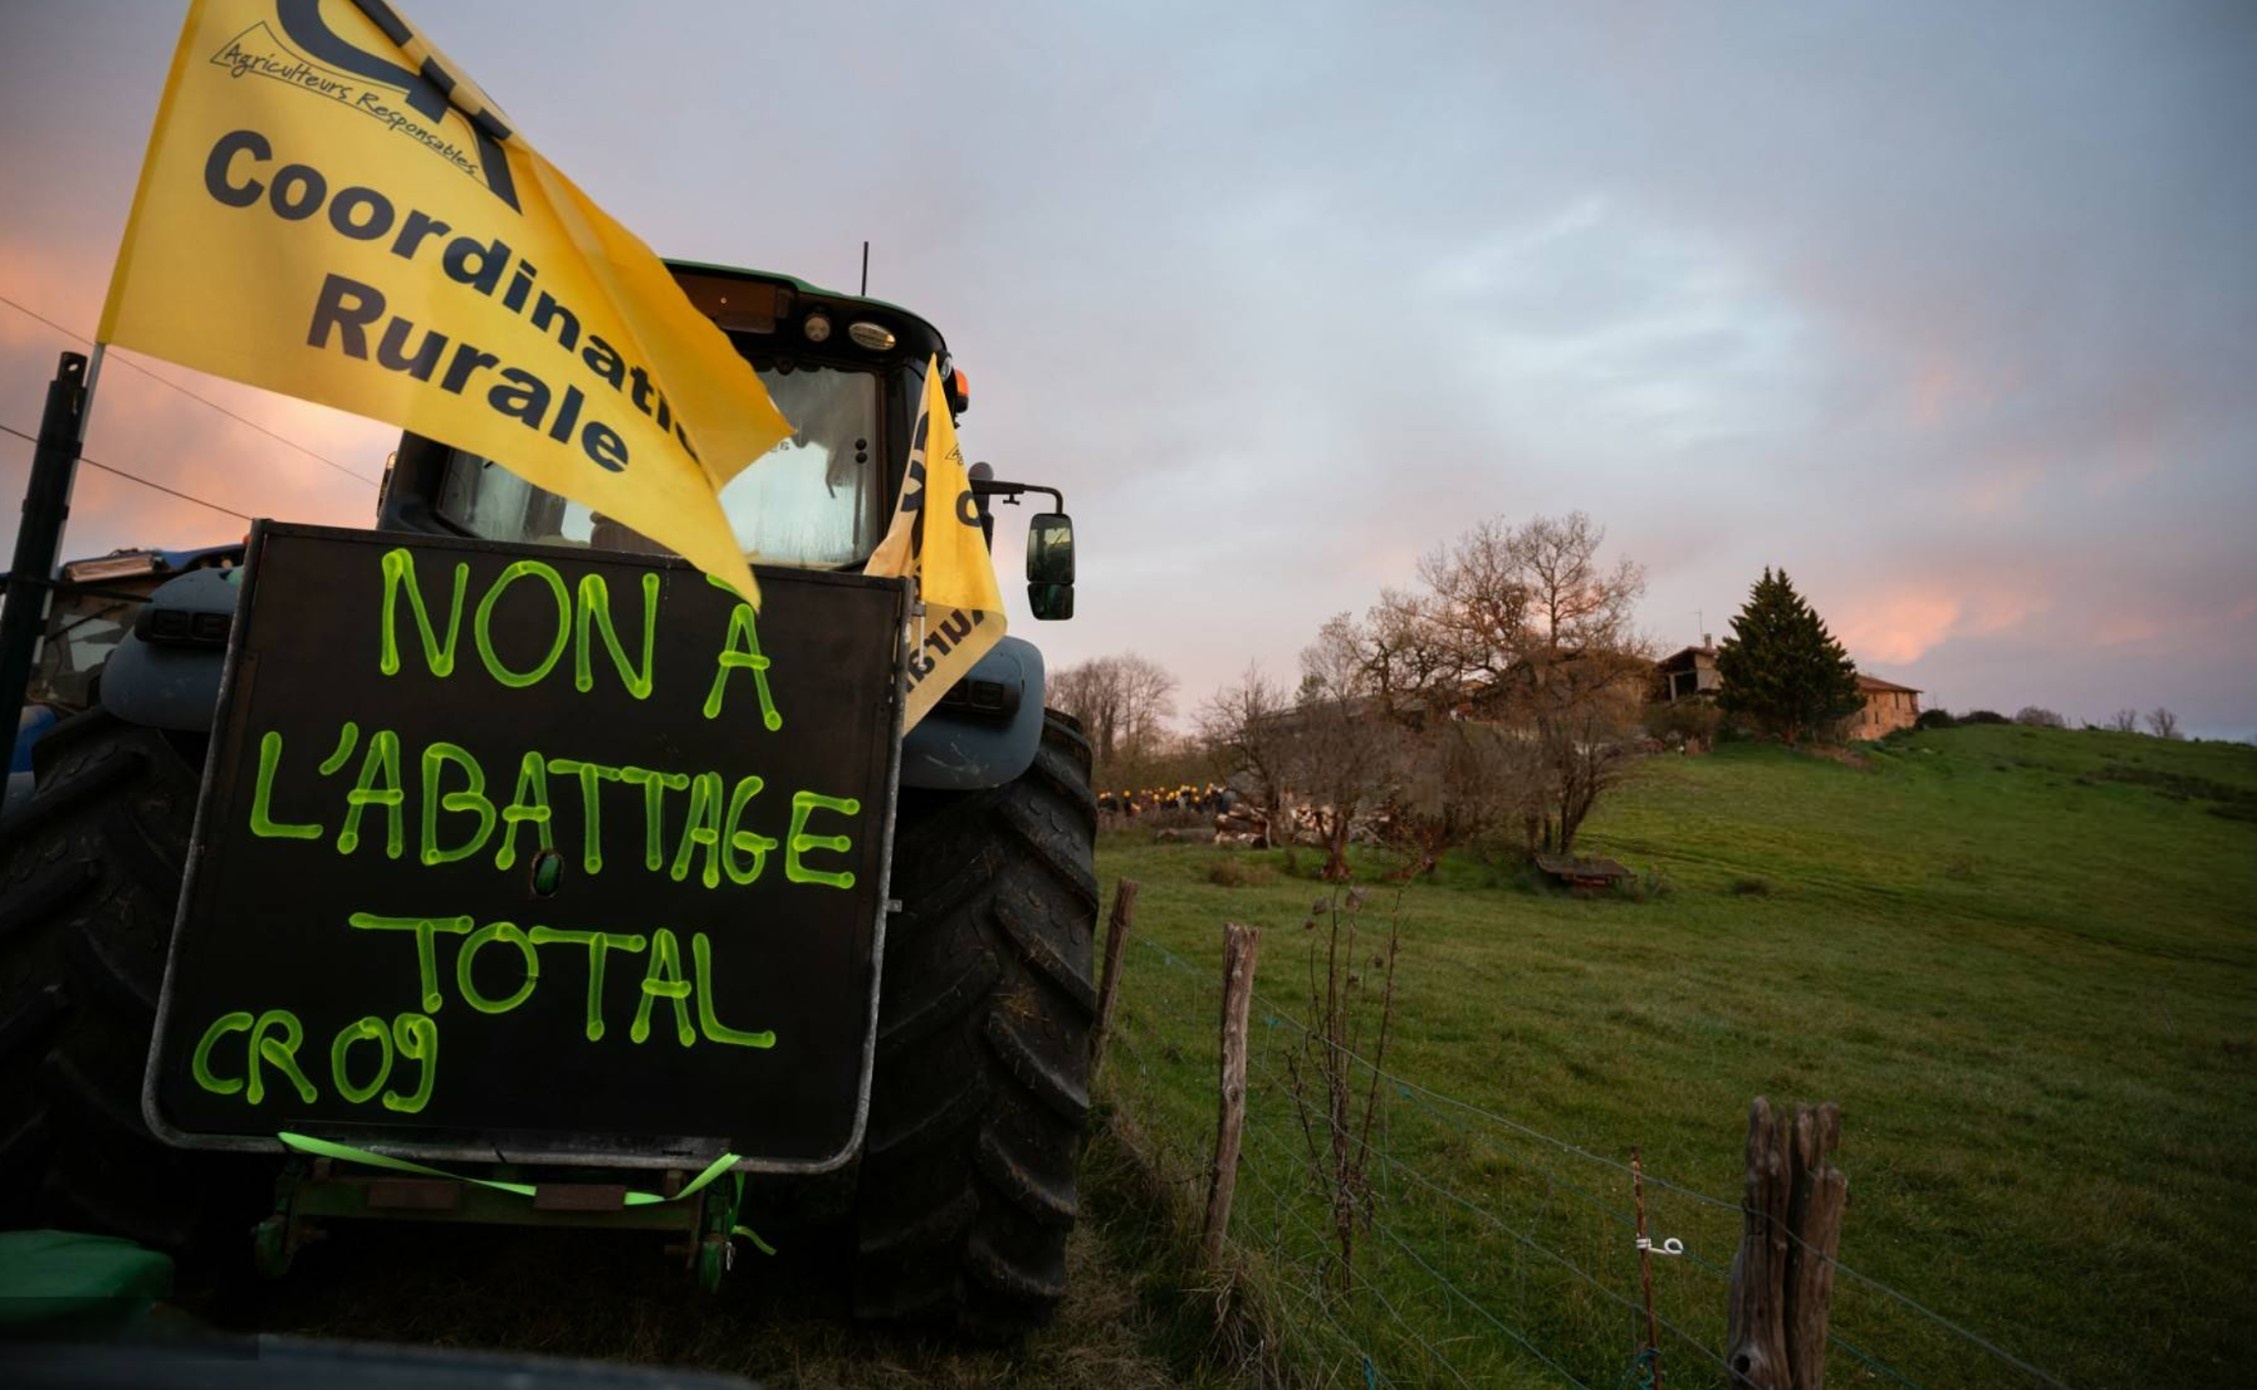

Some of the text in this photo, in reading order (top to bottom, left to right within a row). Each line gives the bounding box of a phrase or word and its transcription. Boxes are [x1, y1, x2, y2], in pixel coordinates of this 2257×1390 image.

[223, 42, 480, 176] Agriculteurs Responsables
[204, 129, 703, 468] Coordinati
[307, 273, 630, 474] Rurale
[379, 547, 661, 701] NON
[249, 721, 862, 890] L'ABATTAGE
[191, 1009, 319, 1105] CR
[348, 912, 778, 1049] TOTAL
